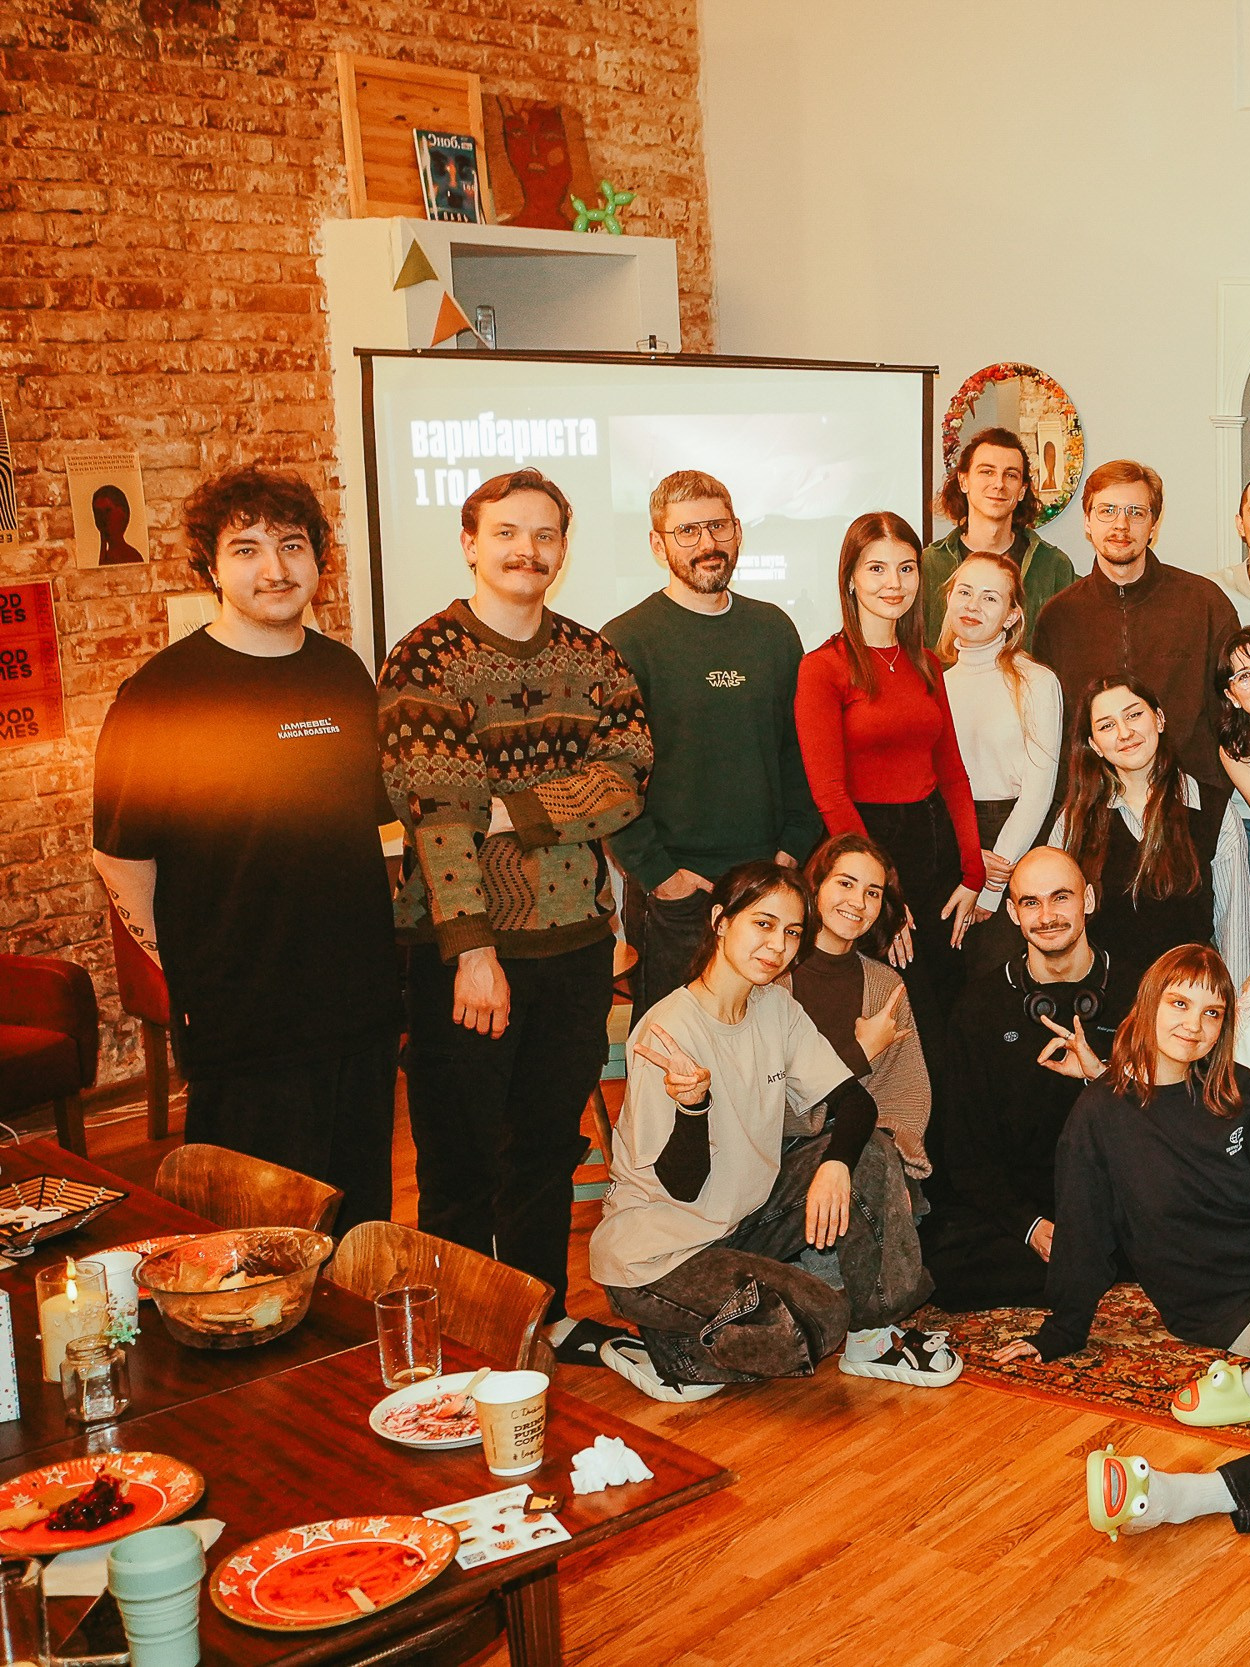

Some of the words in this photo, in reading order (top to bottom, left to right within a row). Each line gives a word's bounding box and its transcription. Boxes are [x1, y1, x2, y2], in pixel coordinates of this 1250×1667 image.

[410, 411, 598, 465] варибариста
[414, 468, 430, 506] 1
[706, 670, 745, 680] STAR
[709, 678, 746, 688] WARS
[303, 725, 340, 737] ROASTERS
